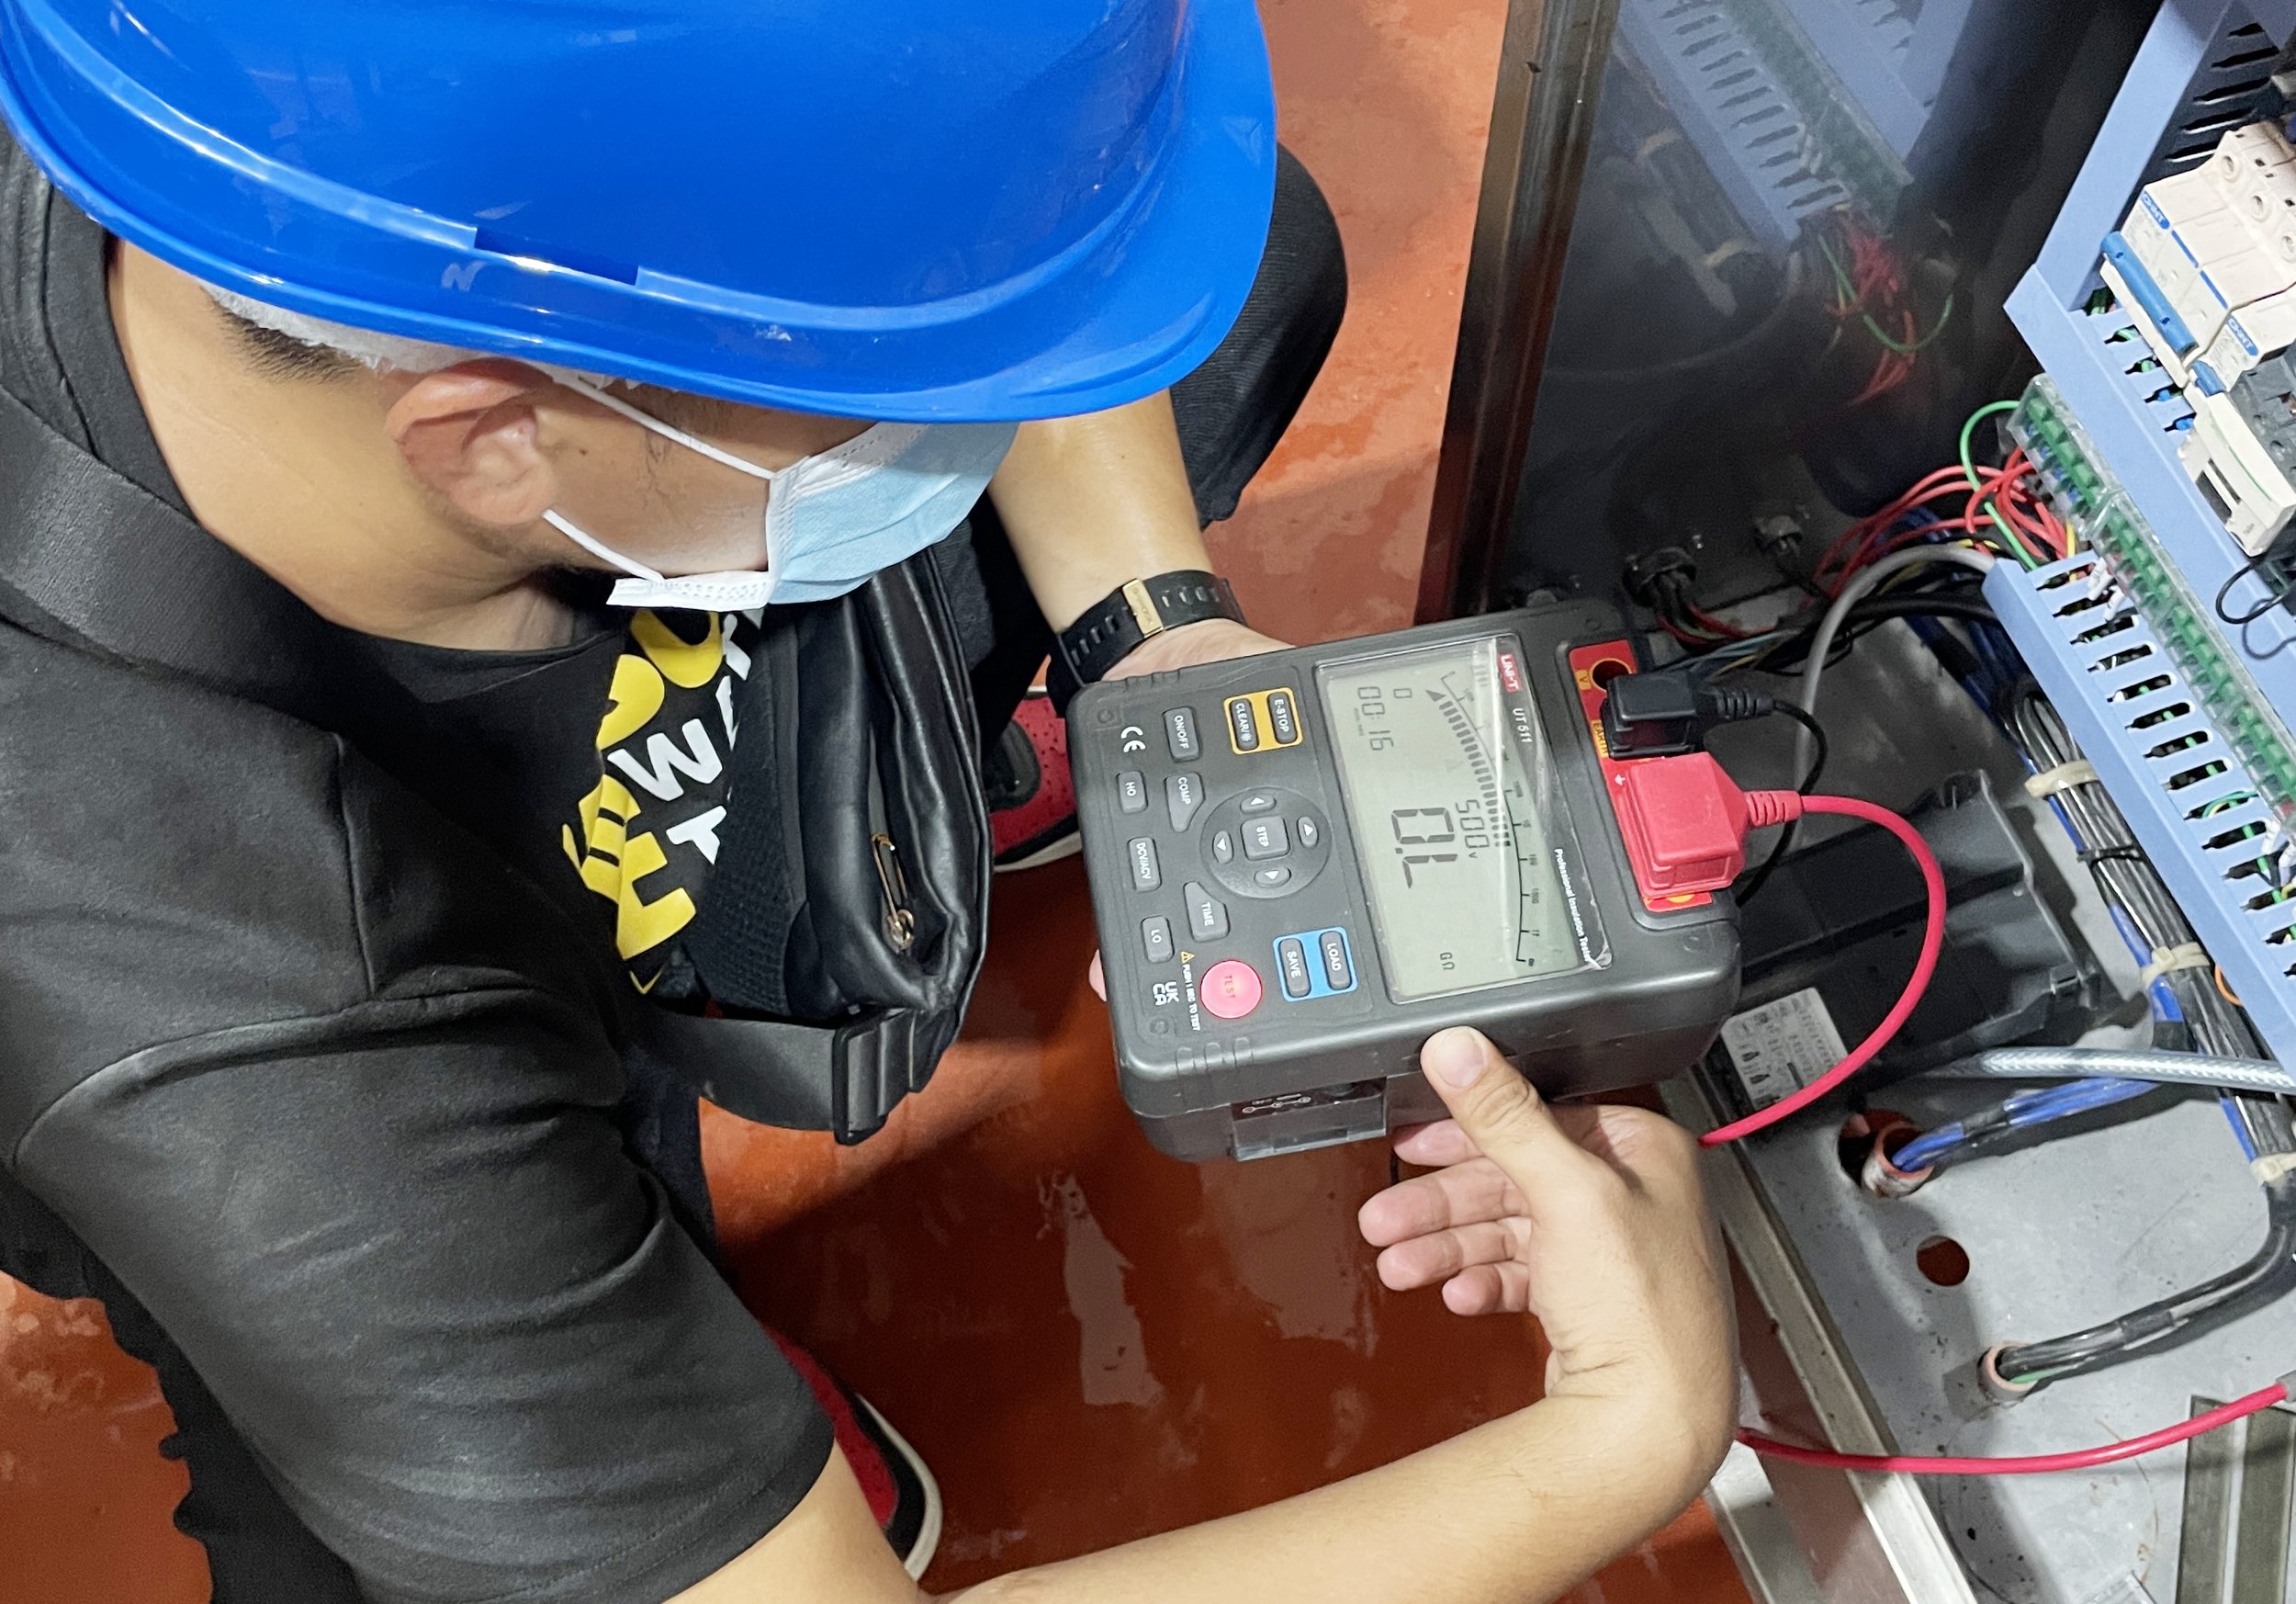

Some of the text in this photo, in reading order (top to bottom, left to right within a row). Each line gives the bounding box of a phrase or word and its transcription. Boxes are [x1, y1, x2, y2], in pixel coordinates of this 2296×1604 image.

[1501, 654, 1520, 690] UNI-T
[1275, 699, 1289, 732] E-STOP
[1174, 715, 1190, 749] ON/OFF
[1178, 776, 1191, 805] COMP
[1255, 826, 1270, 847] STEP
[1136, 842, 1152, 879] DCV/ACV
[1201, 901, 1214, 927] TIME
[1554, 848, 1591, 962] Professional Insulation Tester
[1287, 951, 1301, 978] SAVE
[1327, 943, 1342, 971] LOAD
[1223, 974, 1237, 1000] TEST
[1187, 1003, 1198, 1014] TO
[1189, 1013, 1201, 1032] TEST
